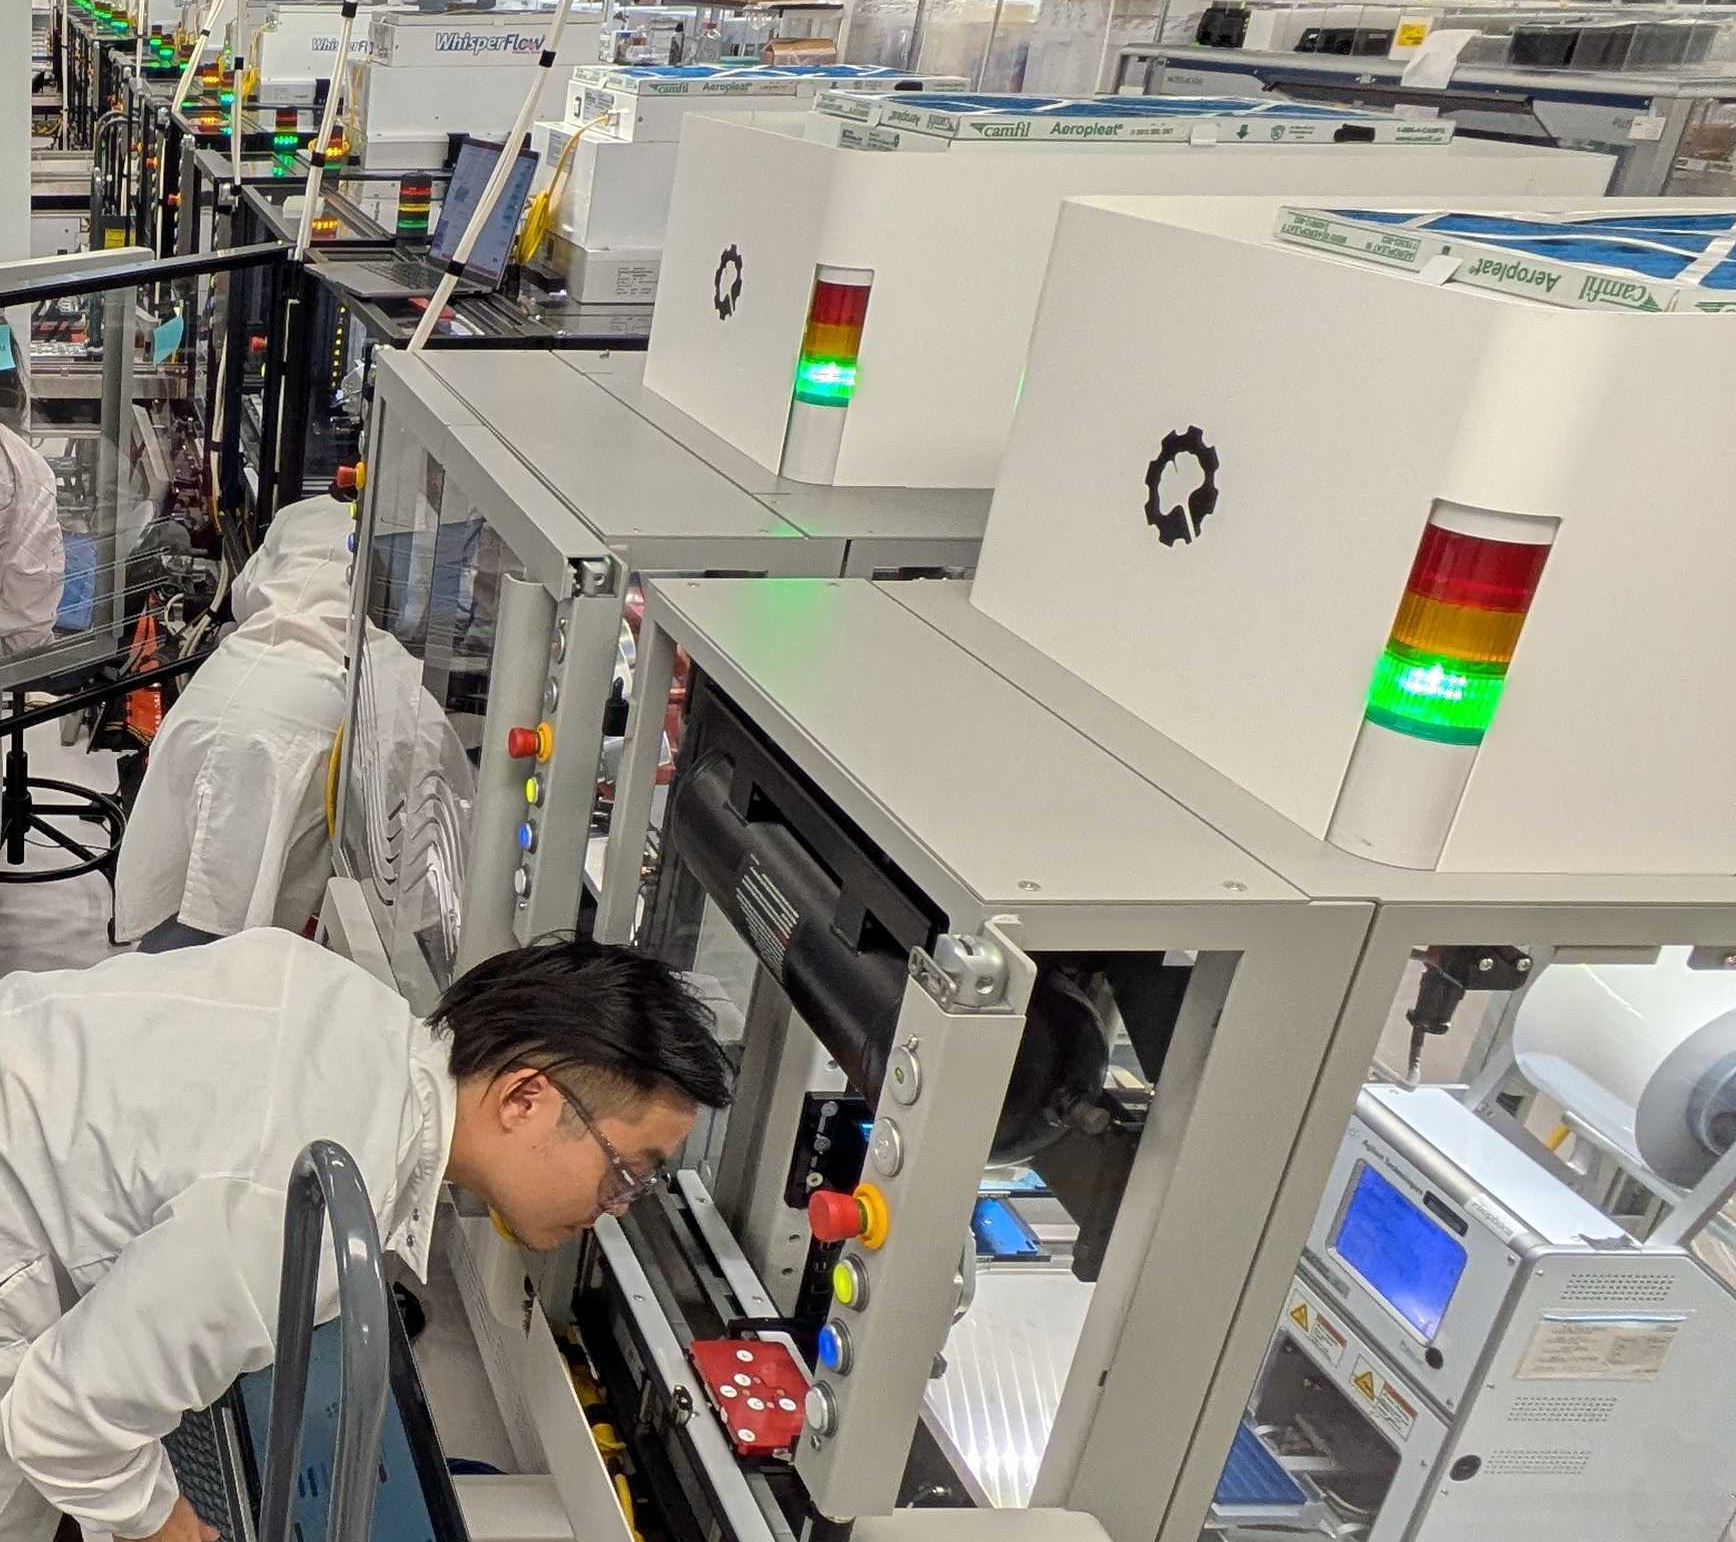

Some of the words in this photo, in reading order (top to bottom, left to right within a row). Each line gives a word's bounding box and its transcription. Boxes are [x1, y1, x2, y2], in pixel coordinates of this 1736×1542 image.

[434, 32, 546, 56] WhisperFlow
[984, 122, 1031, 138] camfil
[1578, 275, 1648, 306] camfil
